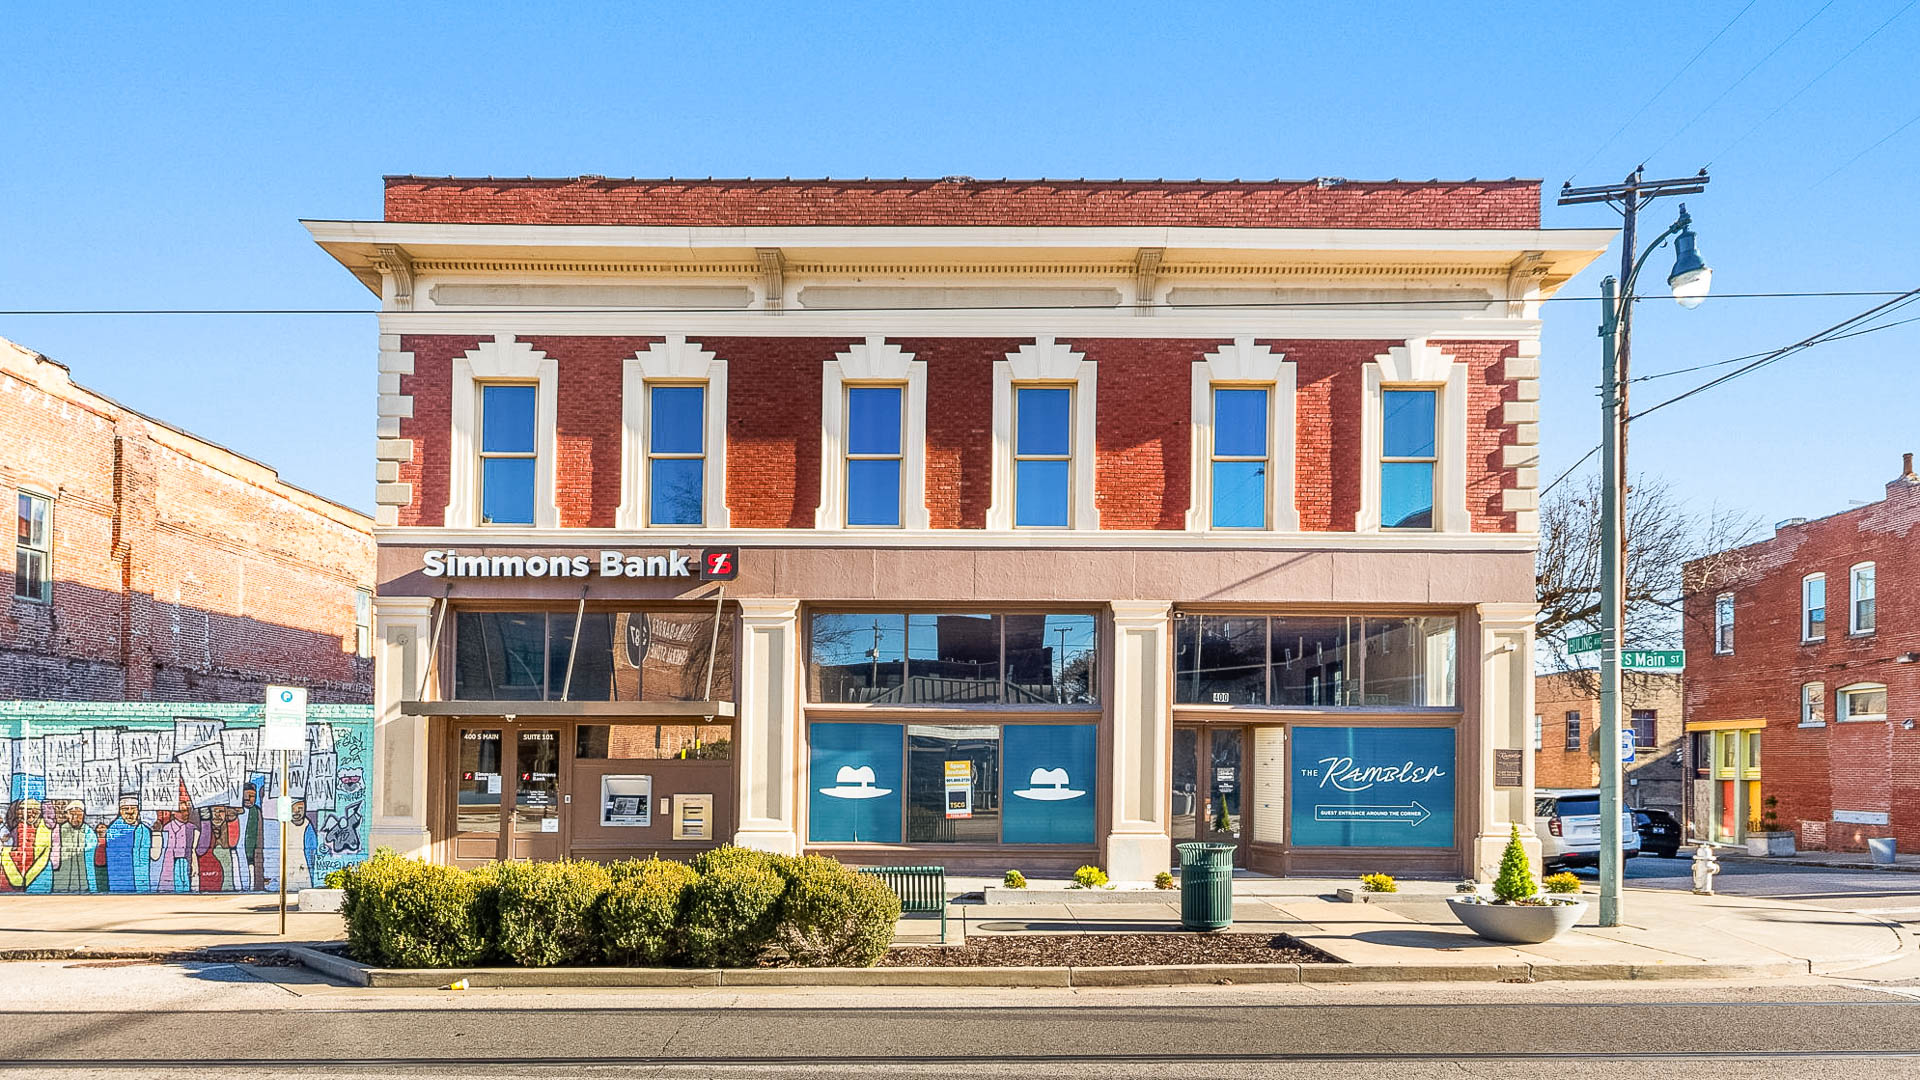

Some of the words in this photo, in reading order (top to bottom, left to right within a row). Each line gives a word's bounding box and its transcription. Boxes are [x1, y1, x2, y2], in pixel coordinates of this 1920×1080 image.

[422, 549, 590, 577] Simmons
[600, 549, 691, 578] Bank
[1569, 636, 1593, 652] HULING
[1625, 653, 1632, 666] S
[1636, 652, 1666, 667] Main
[1671, 655, 1680, 664] ST
[1213, 692, 1229, 702] 400
[1301, 769, 1318, 777] THE
